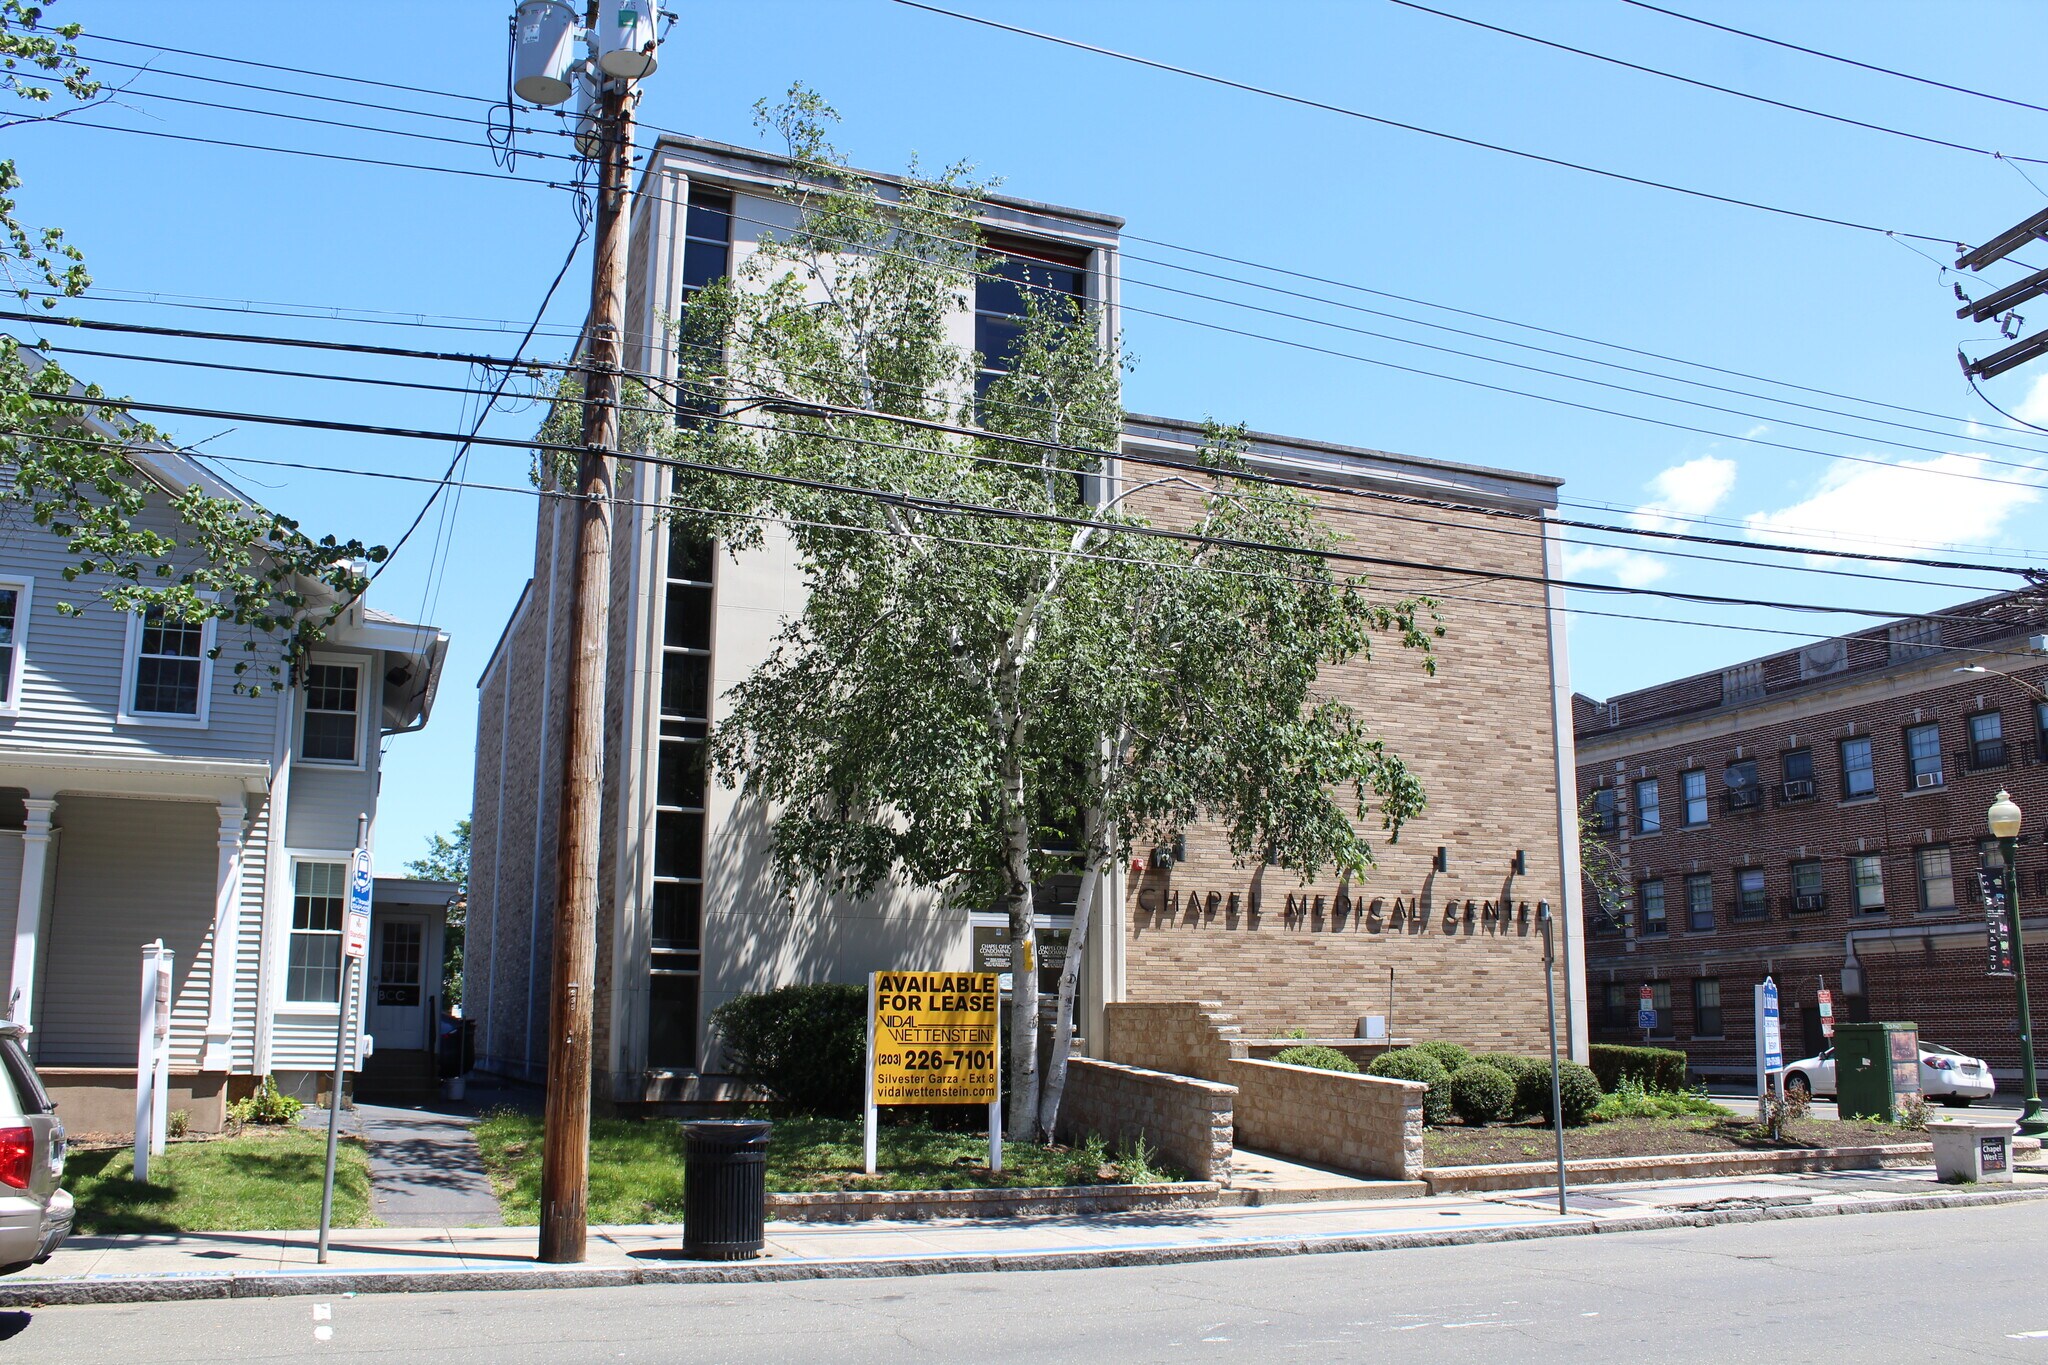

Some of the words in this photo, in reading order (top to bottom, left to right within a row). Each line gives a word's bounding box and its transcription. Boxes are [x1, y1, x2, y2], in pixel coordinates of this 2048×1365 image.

[1980, 873, 1992, 906] WEST
[1138, 888, 1264, 915] CHAPEL
[1288, 893, 1421, 921] MEDICAL
[1989, 921, 1997, 970] CHAPEL
[878, 976, 995, 993] AVAILABLE
[879, 995, 922, 1011] FOR
[929, 995, 995, 1012] LEASE
[879, 1015, 918, 1028] VIDAL
[888, 1028, 990, 1042] WETTENSTEIN
[878, 1053, 902, 1066] (203)
[904, 1050, 995, 1070] 226-7101
[877, 1073, 925, 1084] Silvester
[928, 1073, 958, 1084] Garza
[969, 1073, 986, 1083] Ext
[988, 1073, 995, 1083] 8
[877, 1086, 995, 1098] vidalwettenstein.com
[1982, 1144, 2002, 1154] Chapel
[1983, 1153, 1998, 1161] West
